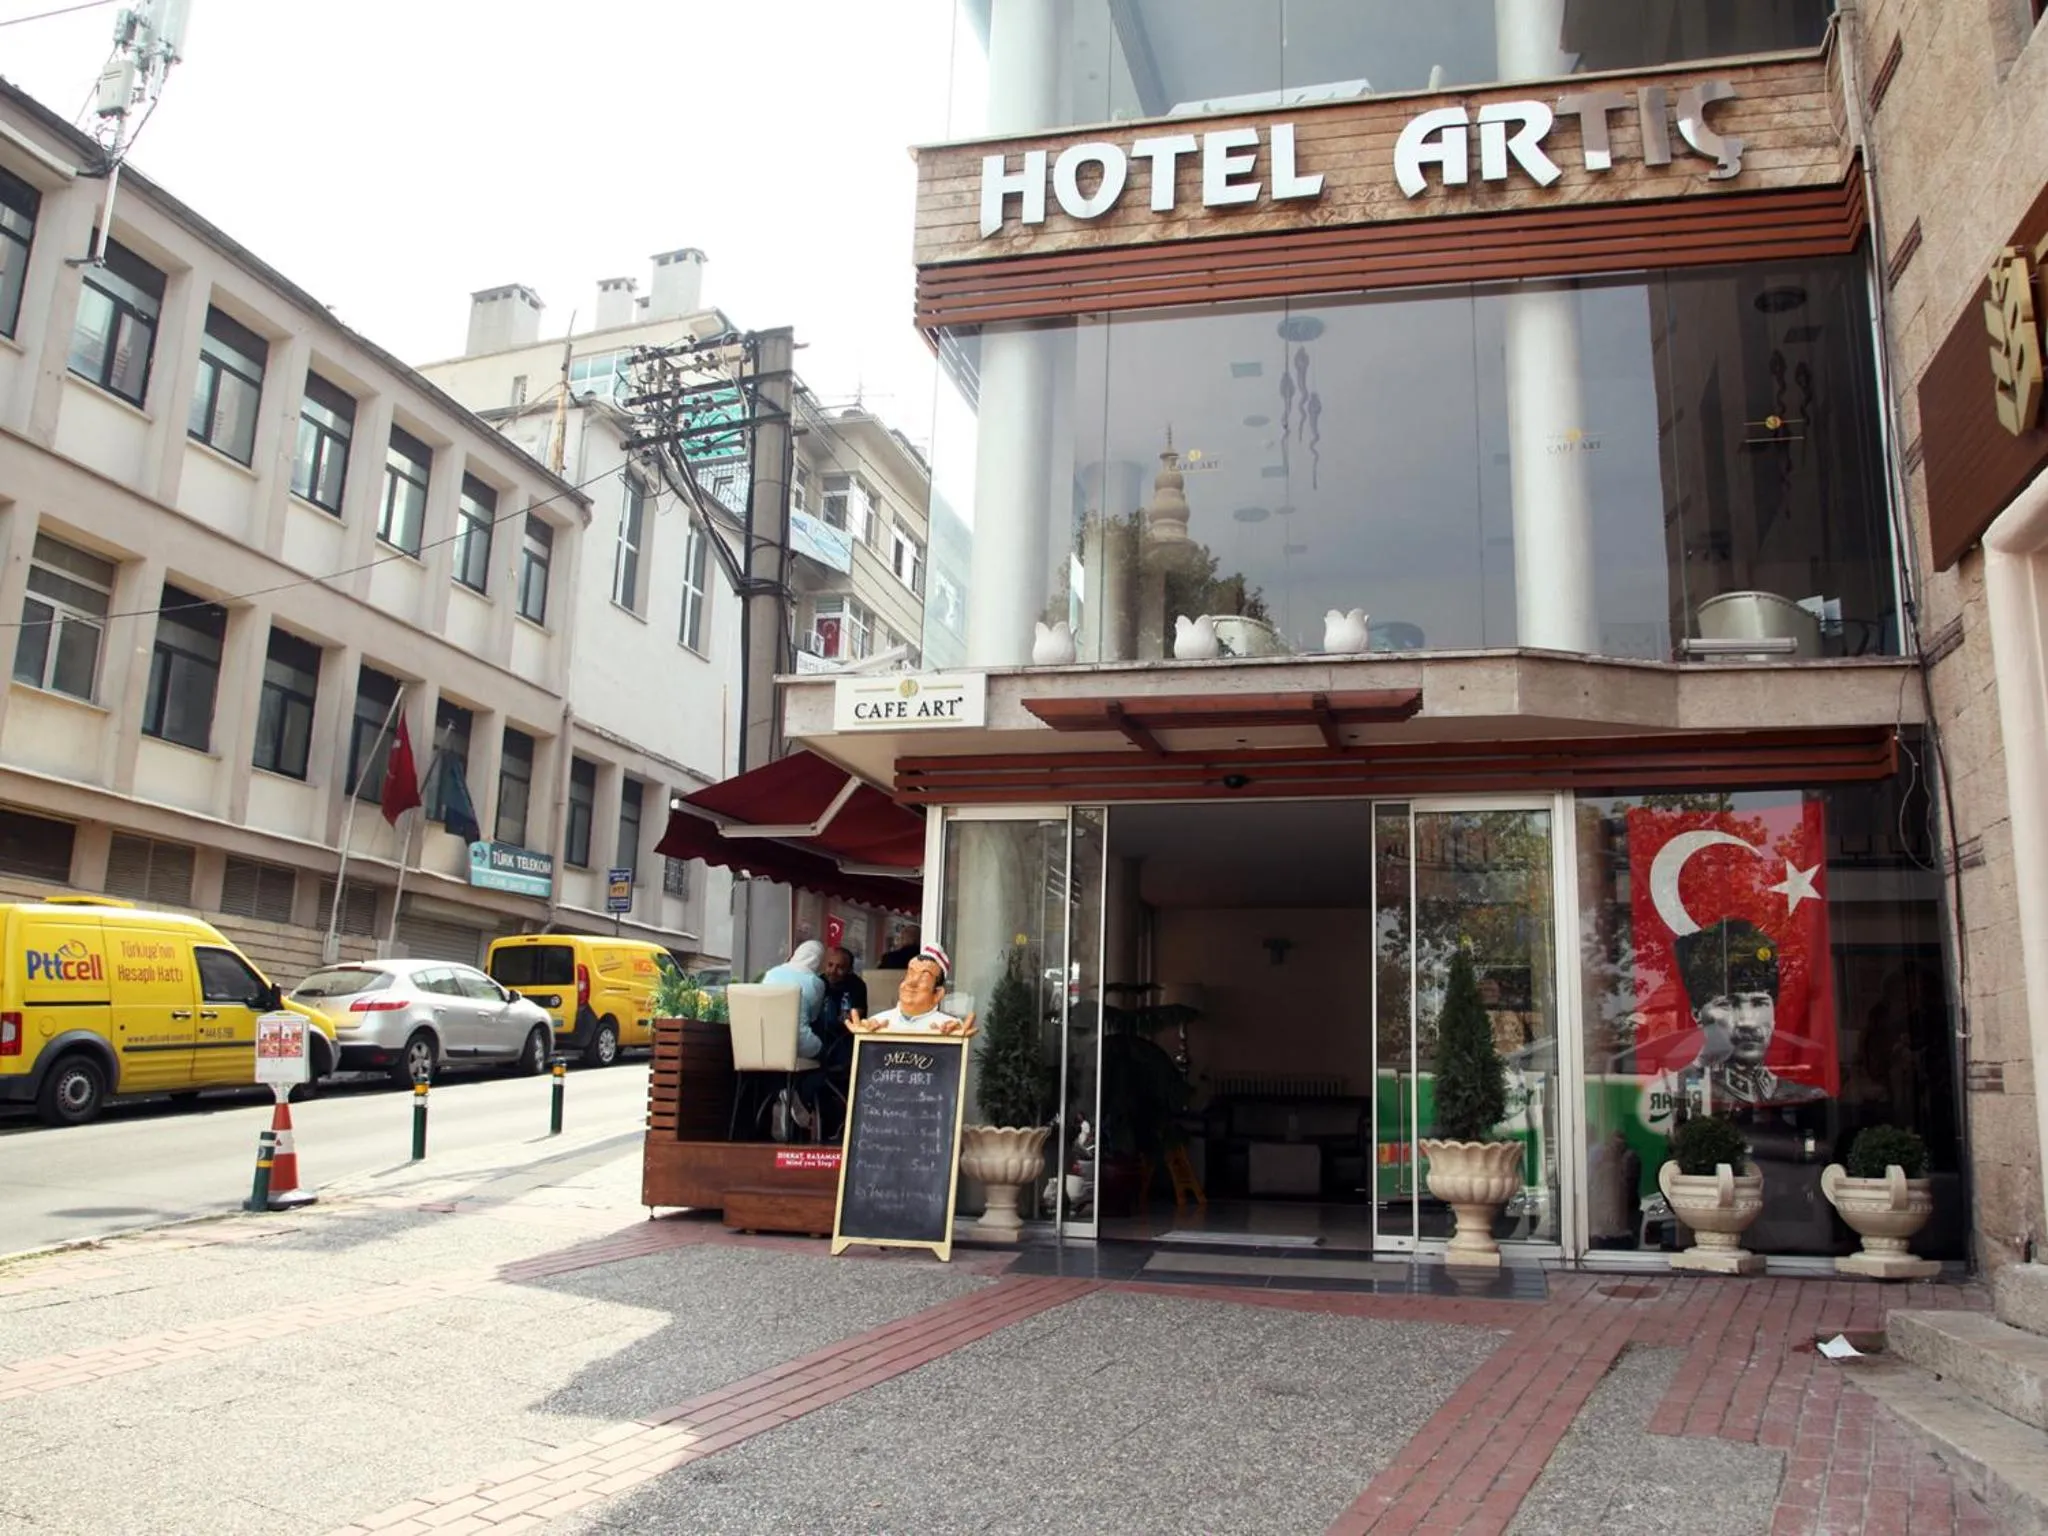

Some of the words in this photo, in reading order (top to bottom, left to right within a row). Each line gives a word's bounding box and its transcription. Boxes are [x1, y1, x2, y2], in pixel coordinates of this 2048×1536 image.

[980, 123, 1325, 240] HOTEL
[854, 701, 908, 719] CAFE
[492, 849, 515, 868] TÜRK
[516, 855, 551, 873] TELEKOM
[26, 949, 104, 981] Pttcell
[157, 965, 184, 983] Hattı
[883, 1051, 934, 1070] MENU
